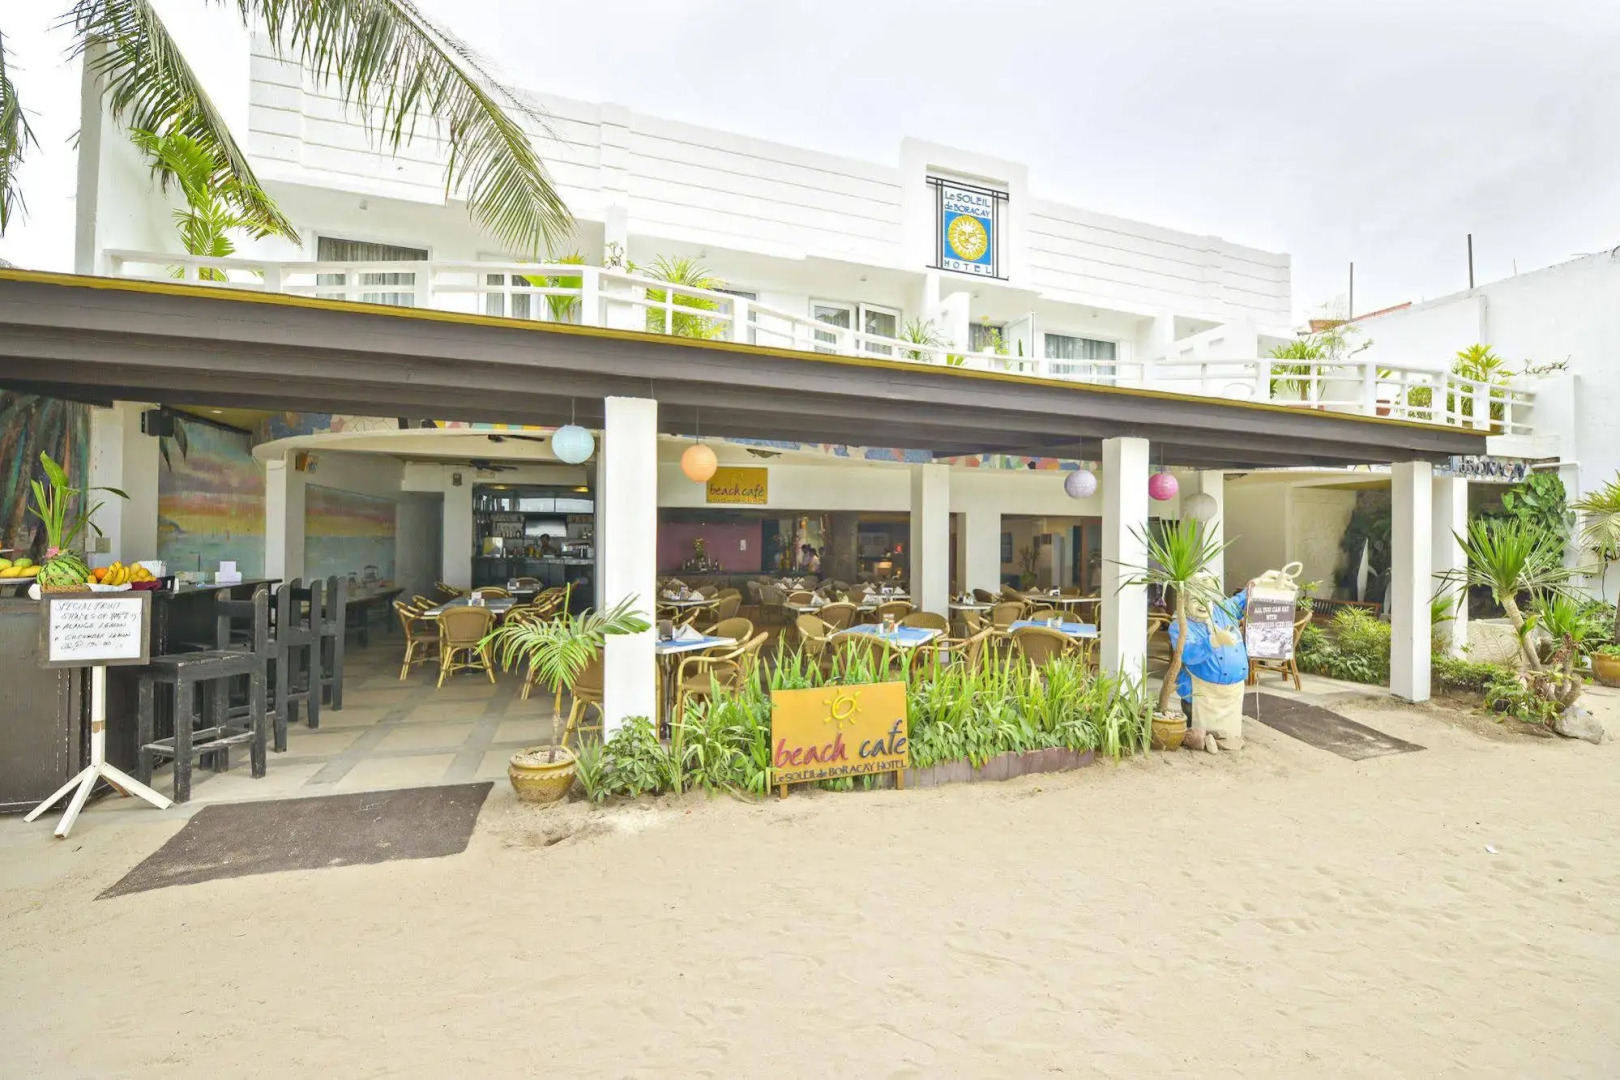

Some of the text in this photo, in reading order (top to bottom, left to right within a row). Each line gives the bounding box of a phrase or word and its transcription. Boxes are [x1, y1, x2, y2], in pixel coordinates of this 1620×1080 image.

[945, 190, 990, 208] Le SOLEIL
[944, 201, 991, 217] de BORACAY
[944, 260, 991, 274] HOTEL
[710, 483, 740, 496] beach
[775, 718, 906, 768] beach cafe
[774, 773, 785, 783] Le
[785, 769, 816, 782] SOLEIL
[829, 762, 874, 777] BORACAY
[877, 759, 907, 771] HOTEL
